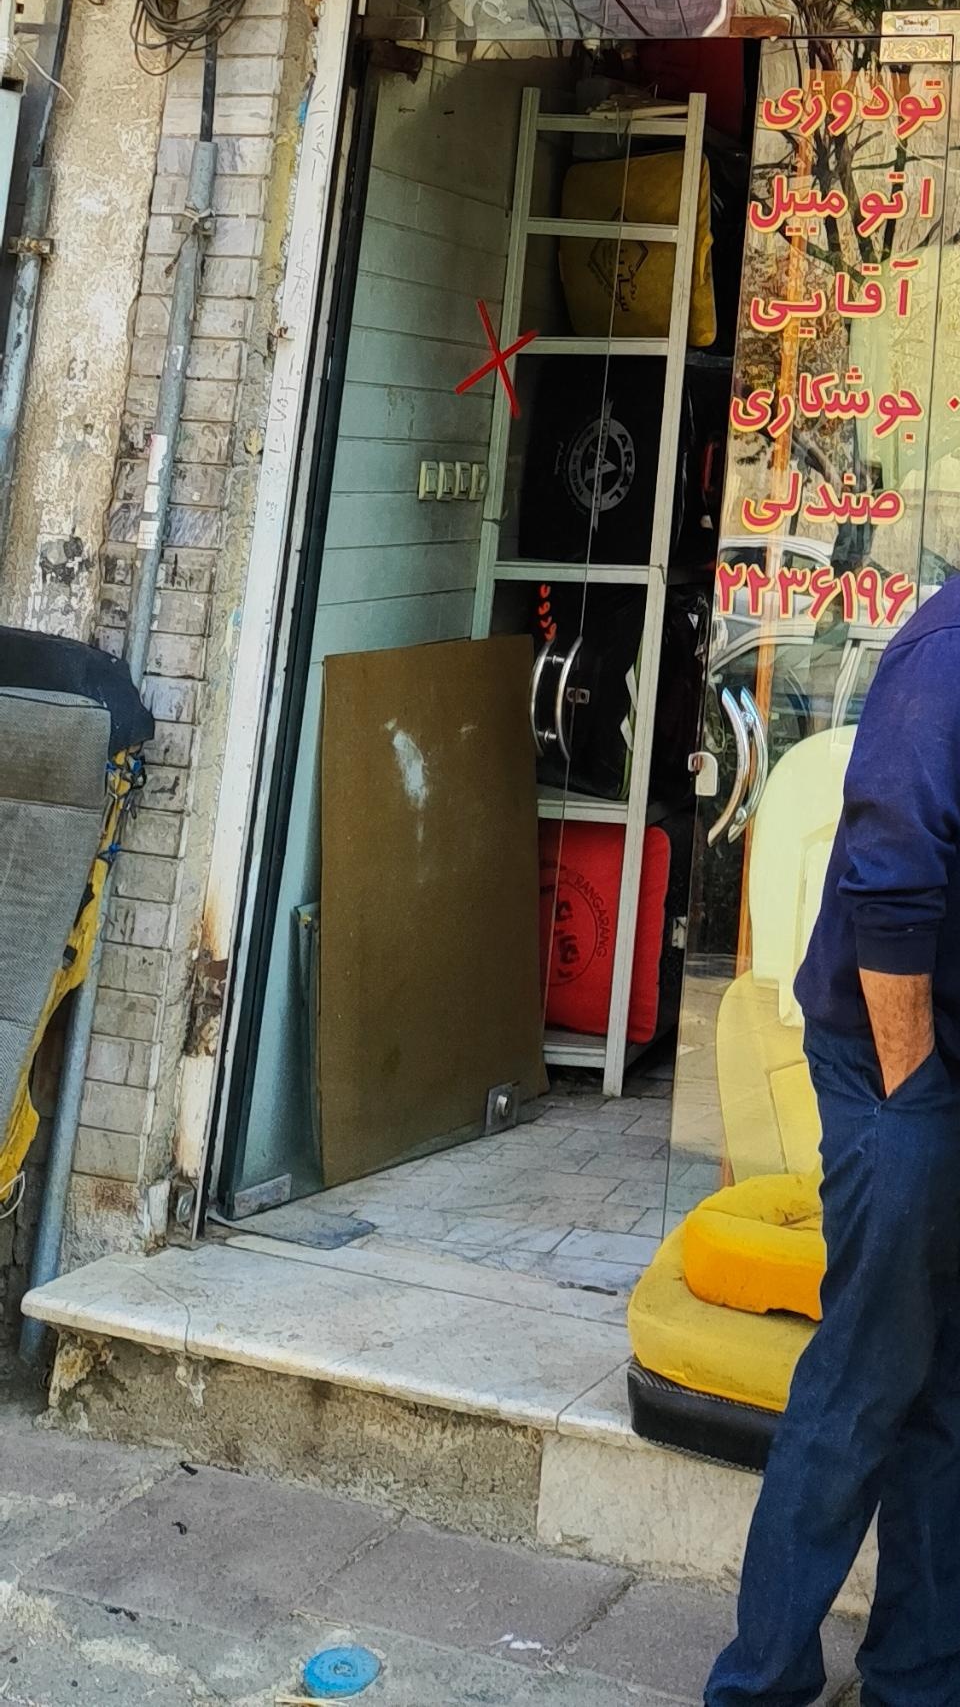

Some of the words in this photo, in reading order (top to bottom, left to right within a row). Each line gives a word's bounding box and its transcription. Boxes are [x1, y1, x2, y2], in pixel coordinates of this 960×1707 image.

[762, 79, 946, 141] تودوزی
[750, 258, 924, 341] آقایی
[730, 366, 926, 444] جوشکاری
[741, 472, 905, 534] صندلی
[716, 561, 917, 628] ۲۲۳۶۱۹۶
